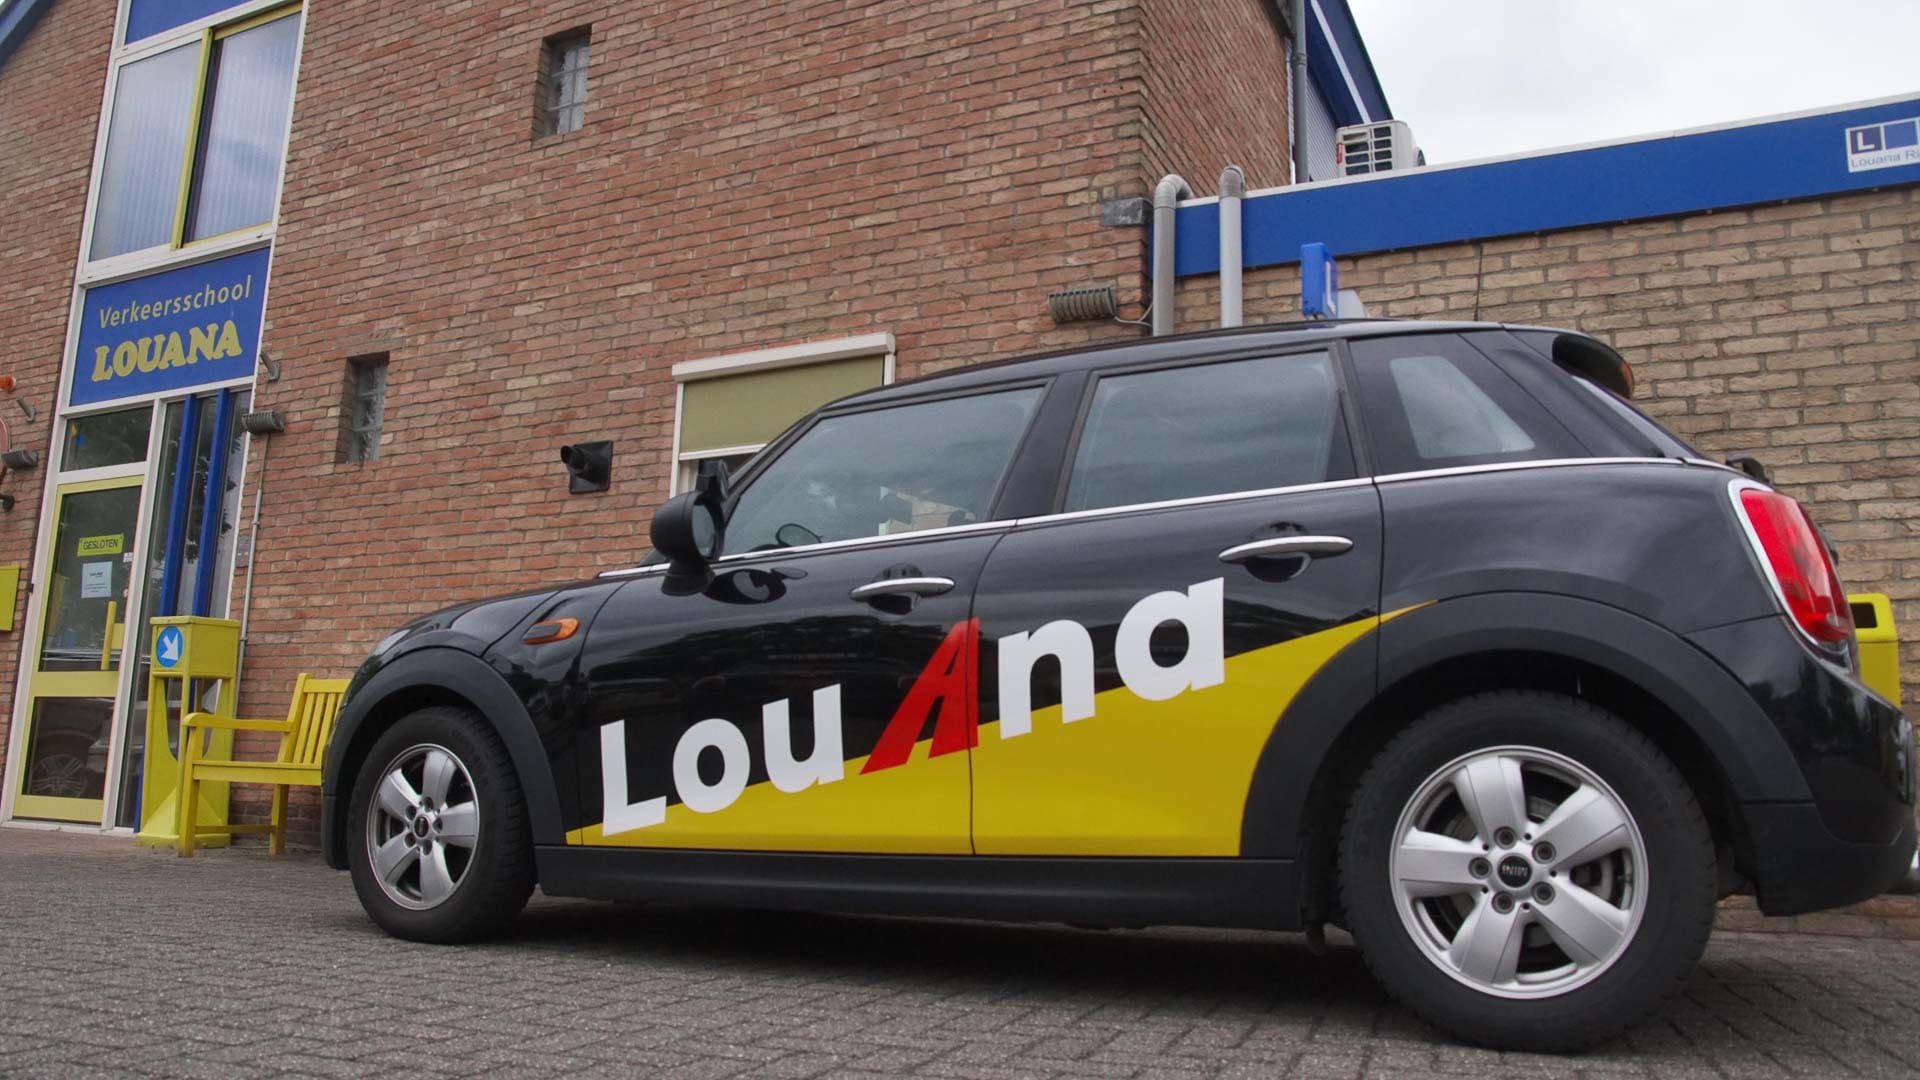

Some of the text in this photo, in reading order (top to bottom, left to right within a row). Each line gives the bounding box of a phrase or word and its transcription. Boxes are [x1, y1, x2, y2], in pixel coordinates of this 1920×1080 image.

[1856, 131, 1875, 151] L
[1851, 154, 1900, 168] Louana
[99, 275, 252, 329] Verkeersschool
[91, 320, 243, 382] LOUANA
[83, 539, 119, 551] GESLOTEN
[600, 577, 1224, 837] LouAna
